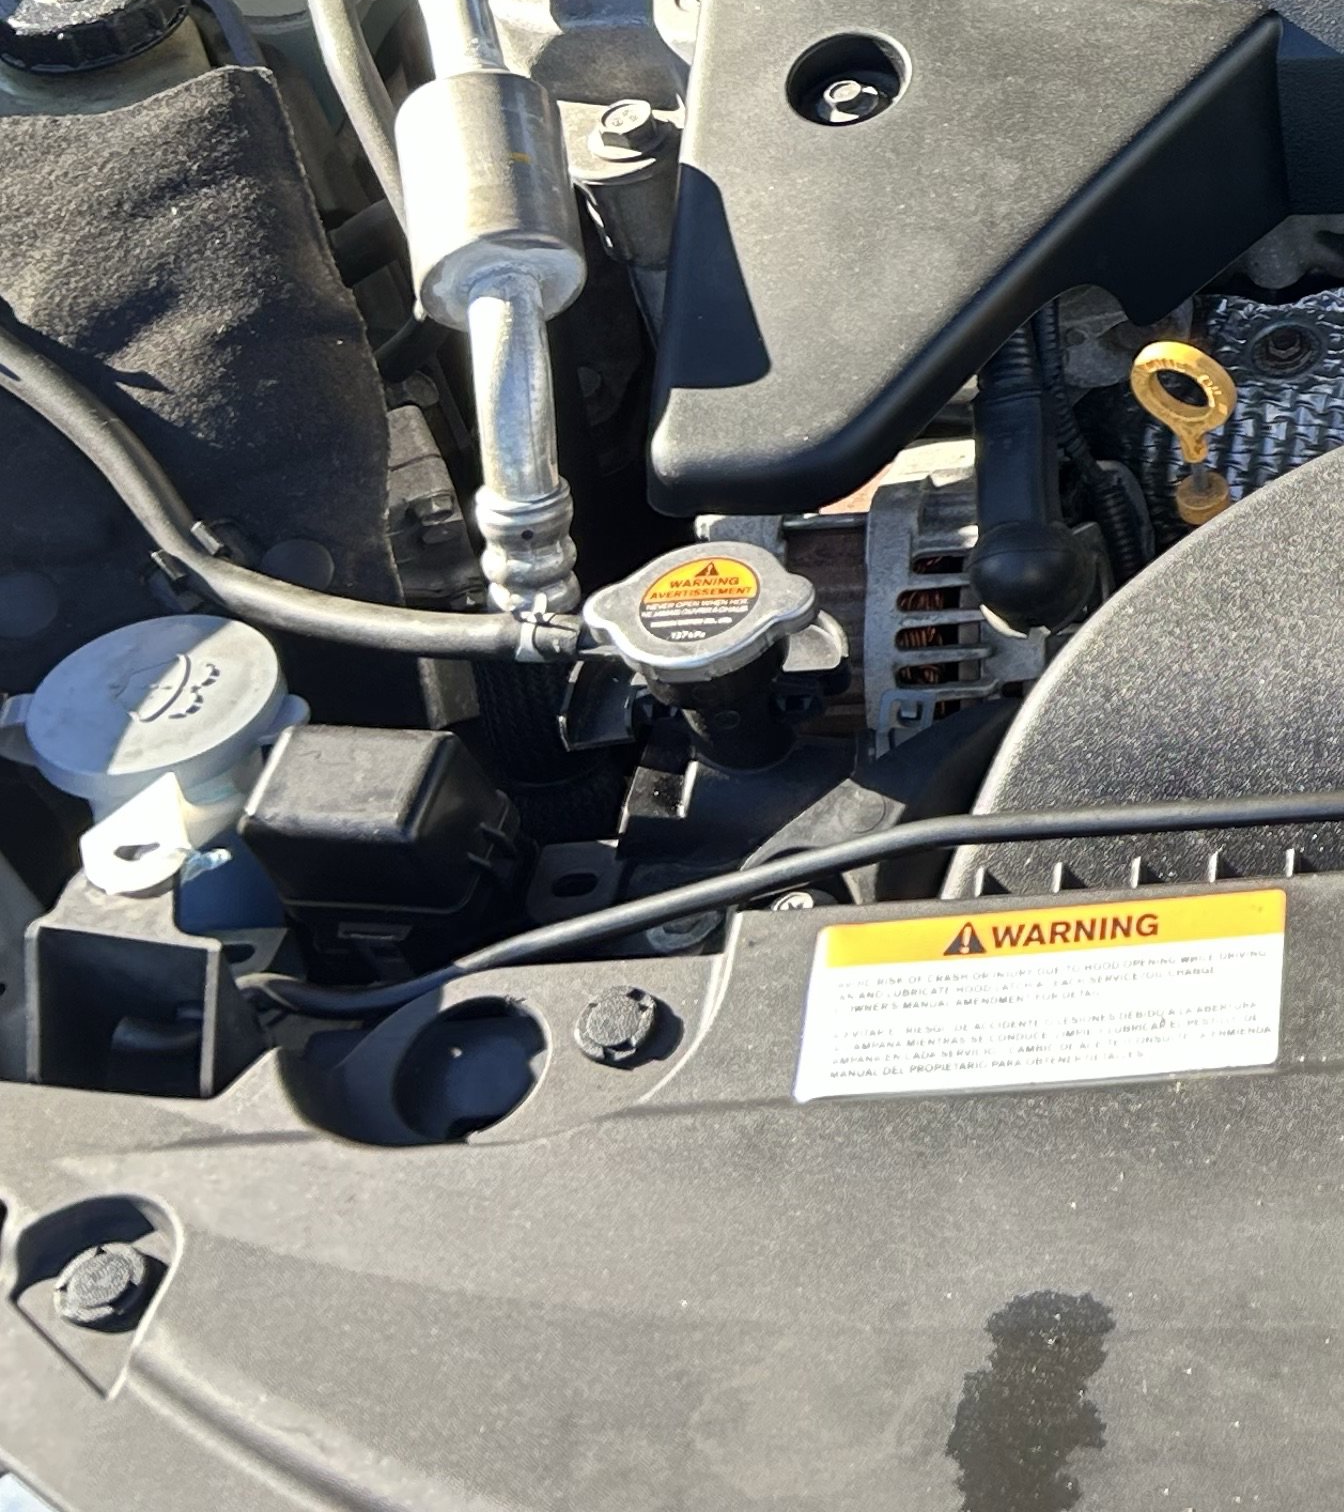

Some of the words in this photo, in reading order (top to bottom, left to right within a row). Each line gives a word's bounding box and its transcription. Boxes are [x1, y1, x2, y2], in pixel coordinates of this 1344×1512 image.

[669, 576, 740, 588] WARNING
[650, 587, 752, 599] AVERTISSEMENT
[992, 913, 1159, 948] WARNING
